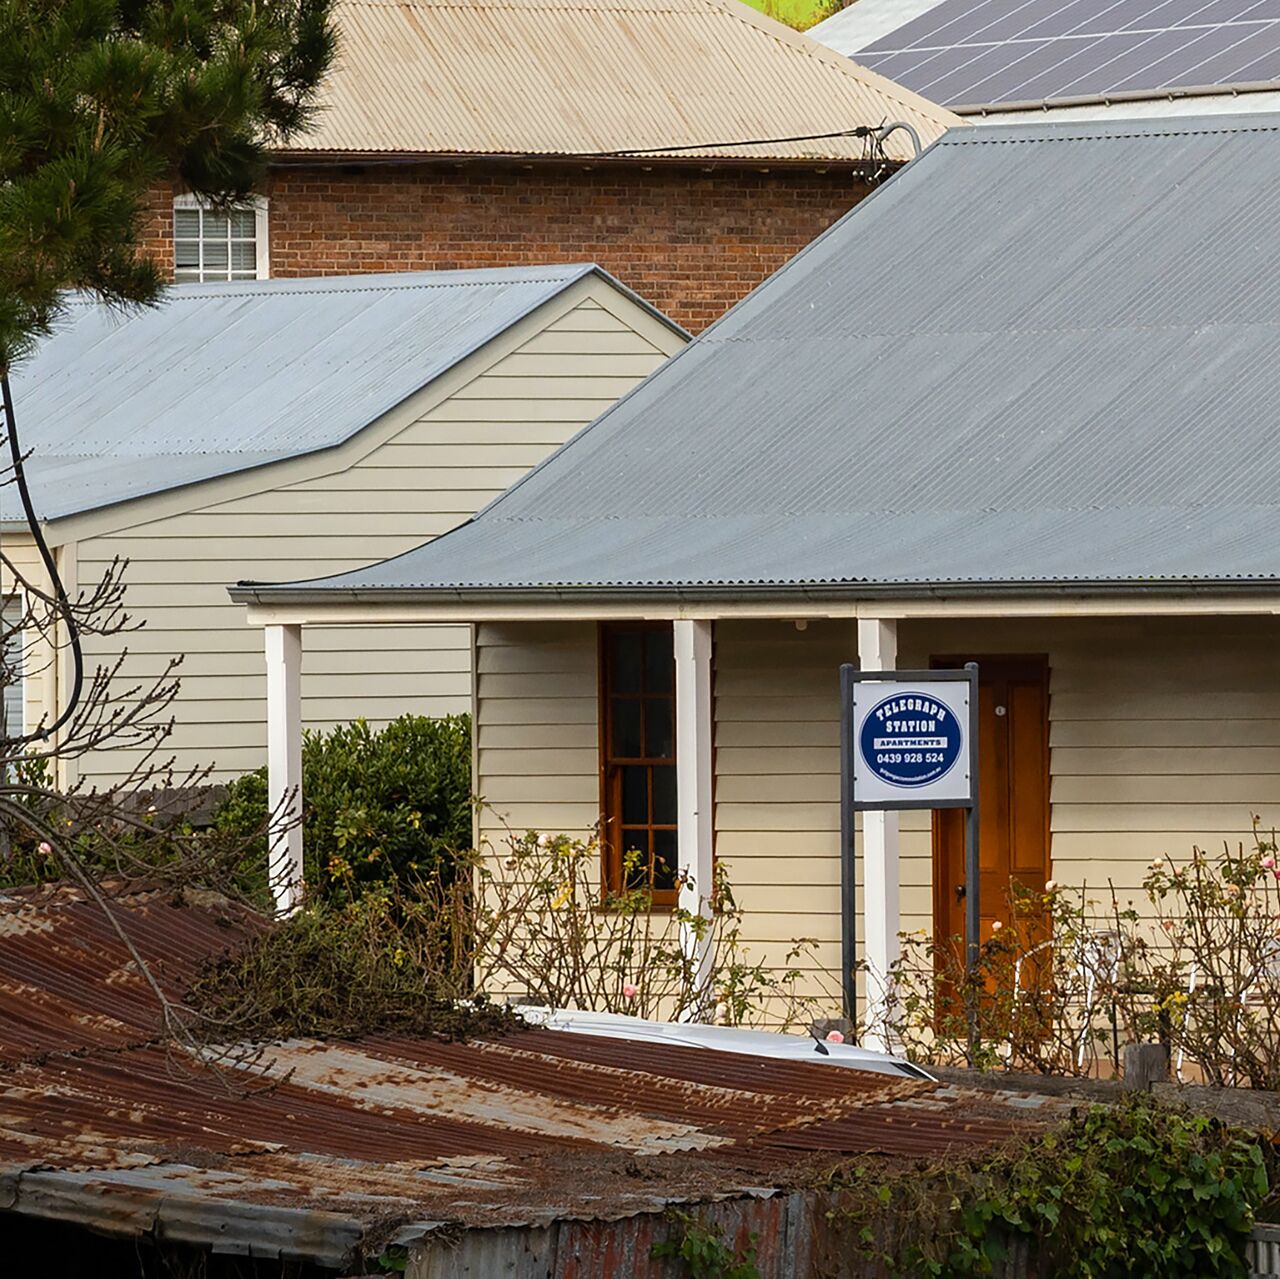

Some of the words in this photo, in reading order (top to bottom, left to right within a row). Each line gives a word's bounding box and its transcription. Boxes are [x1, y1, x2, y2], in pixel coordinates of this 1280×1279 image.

[876, 699, 946, 721] TELEGRAPH
[886, 720, 935, 732] STATION
[877, 753, 902, 763] 0439
[904, 753, 923, 763] 928
[925, 753, 944, 763] 524
